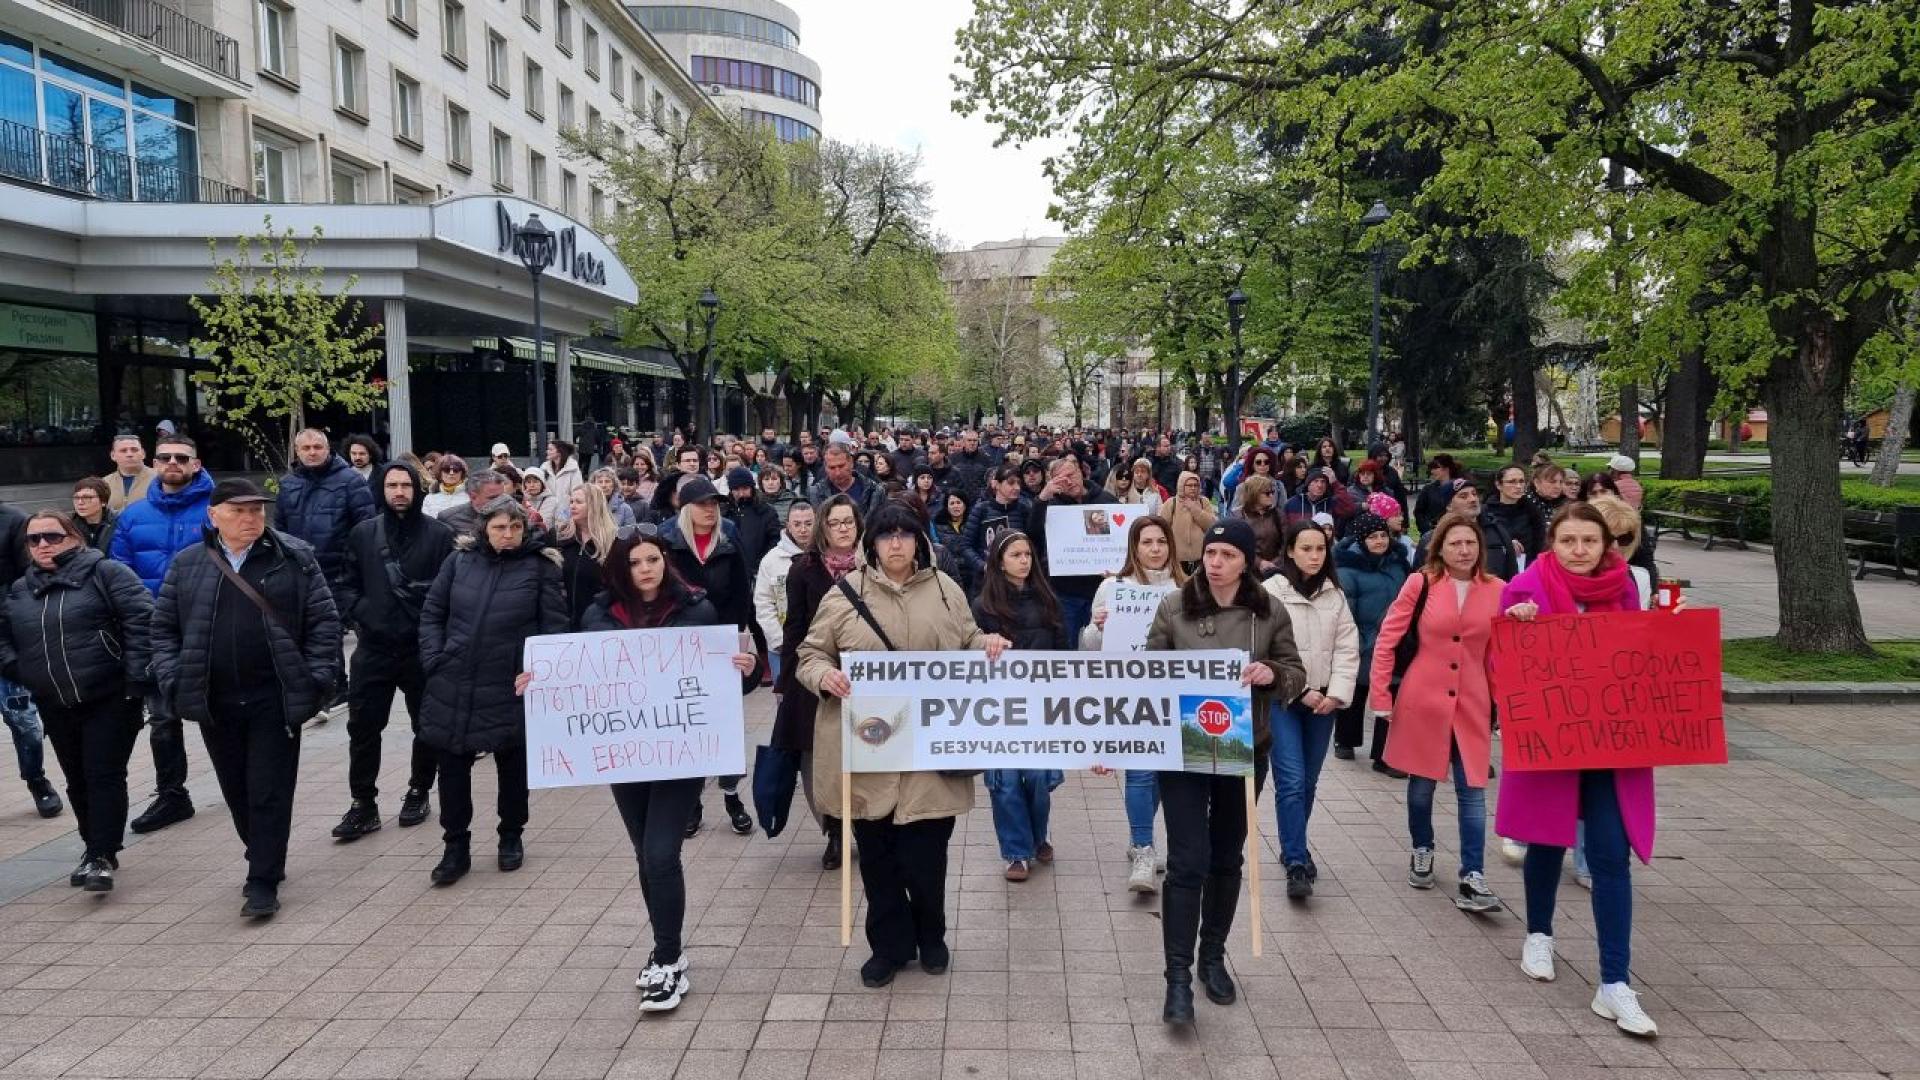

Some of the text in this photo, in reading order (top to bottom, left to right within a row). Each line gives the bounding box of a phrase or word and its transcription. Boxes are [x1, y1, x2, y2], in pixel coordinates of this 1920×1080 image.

[561, 225, 606, 285] Plaza
[1116, 604, 1152, 615] НЯМА
[850, 659, 1242, 684] #НИТОЕДНОДЕТЕПОВЕЧЕ#
[920, 697, 1171, 727] РУСЕ ИСКА!
[1507, 680, 1712, 721] Е ПО СЮЖЕТ
[566, 702, 708, 736] ГРОБИЩЕ
[1198, 710, 1231, 726] STOP
[542, 731, 720, 776] НА ЕВРОПА!!!
[930, 739, 1165, 755] БЕЗУЧАСТИЕТО УБИВА!
[1515, 730, 1552, 762] НА
[1659, 717, 1723, 751] КИНГ
